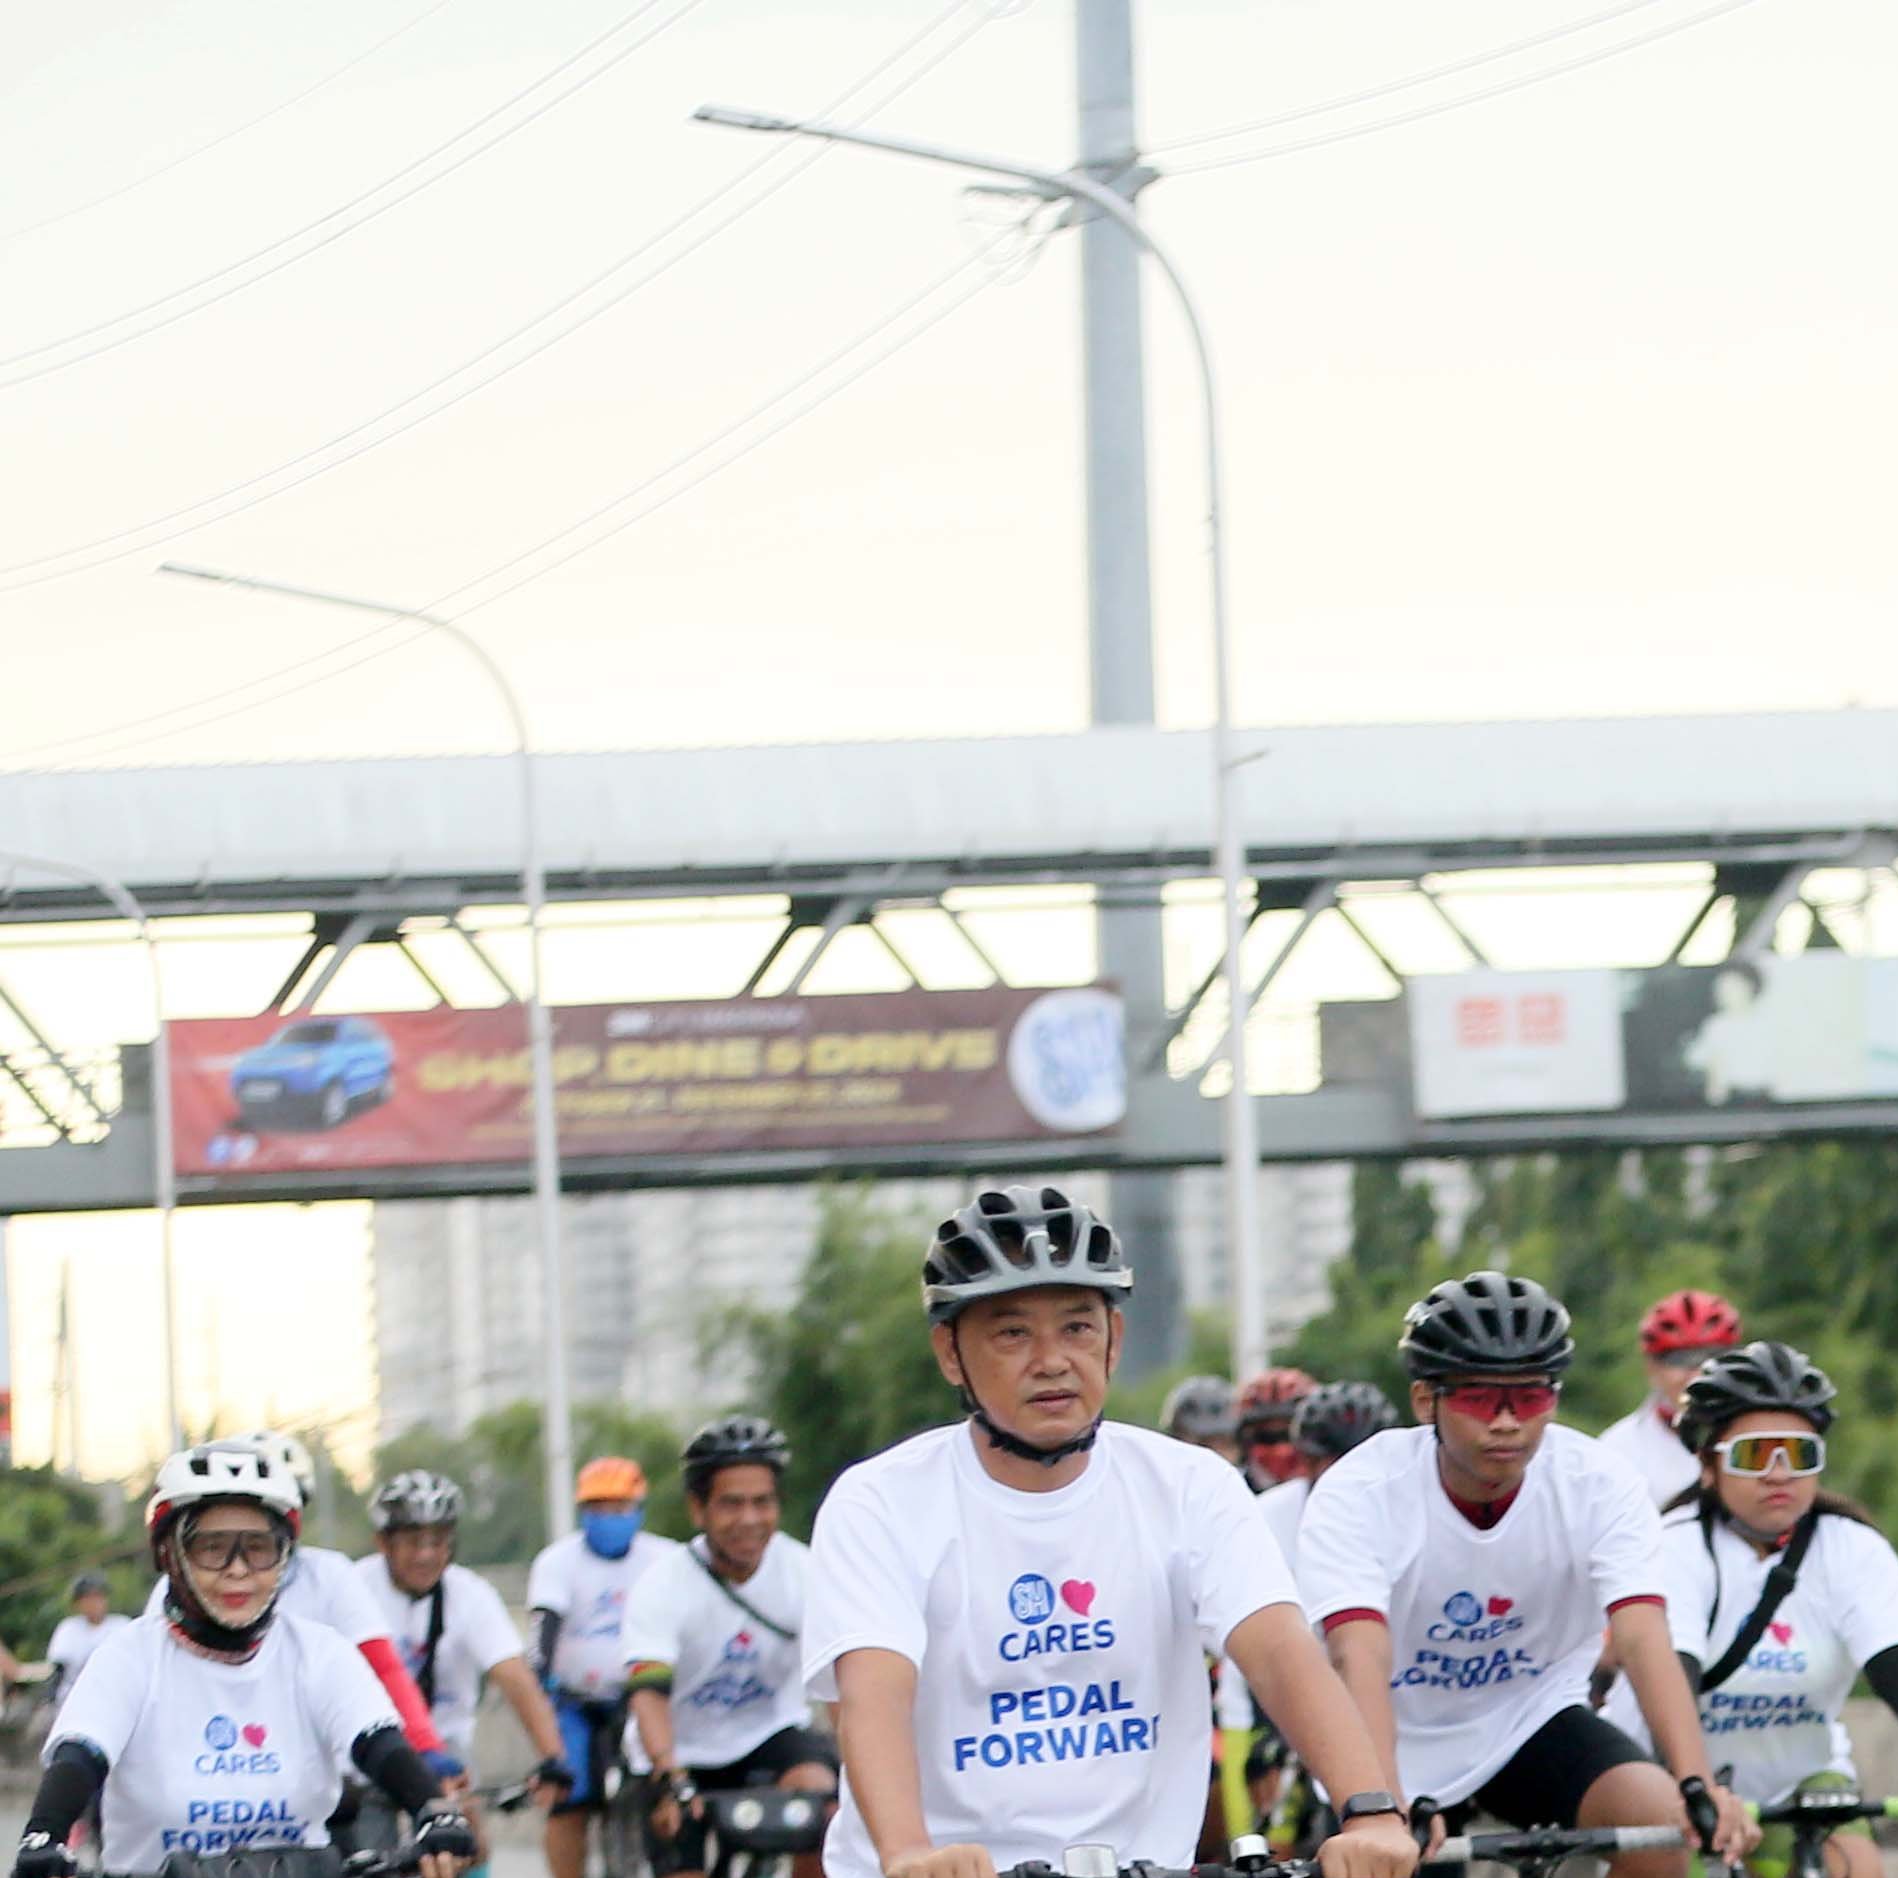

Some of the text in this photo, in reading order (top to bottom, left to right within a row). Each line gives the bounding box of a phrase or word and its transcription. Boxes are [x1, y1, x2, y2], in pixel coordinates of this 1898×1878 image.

[998, 1619, 1116, 1662] CARES
[1426, 1616, 1524, 1643] CARES
[990, 1680, 1134, 1725] PEDAL
[953, 1713, 1161, 1772] FORWAR
[194, 1751, 281, 1775] CARES
[188, 1799, 296, 1824] PEDAL
